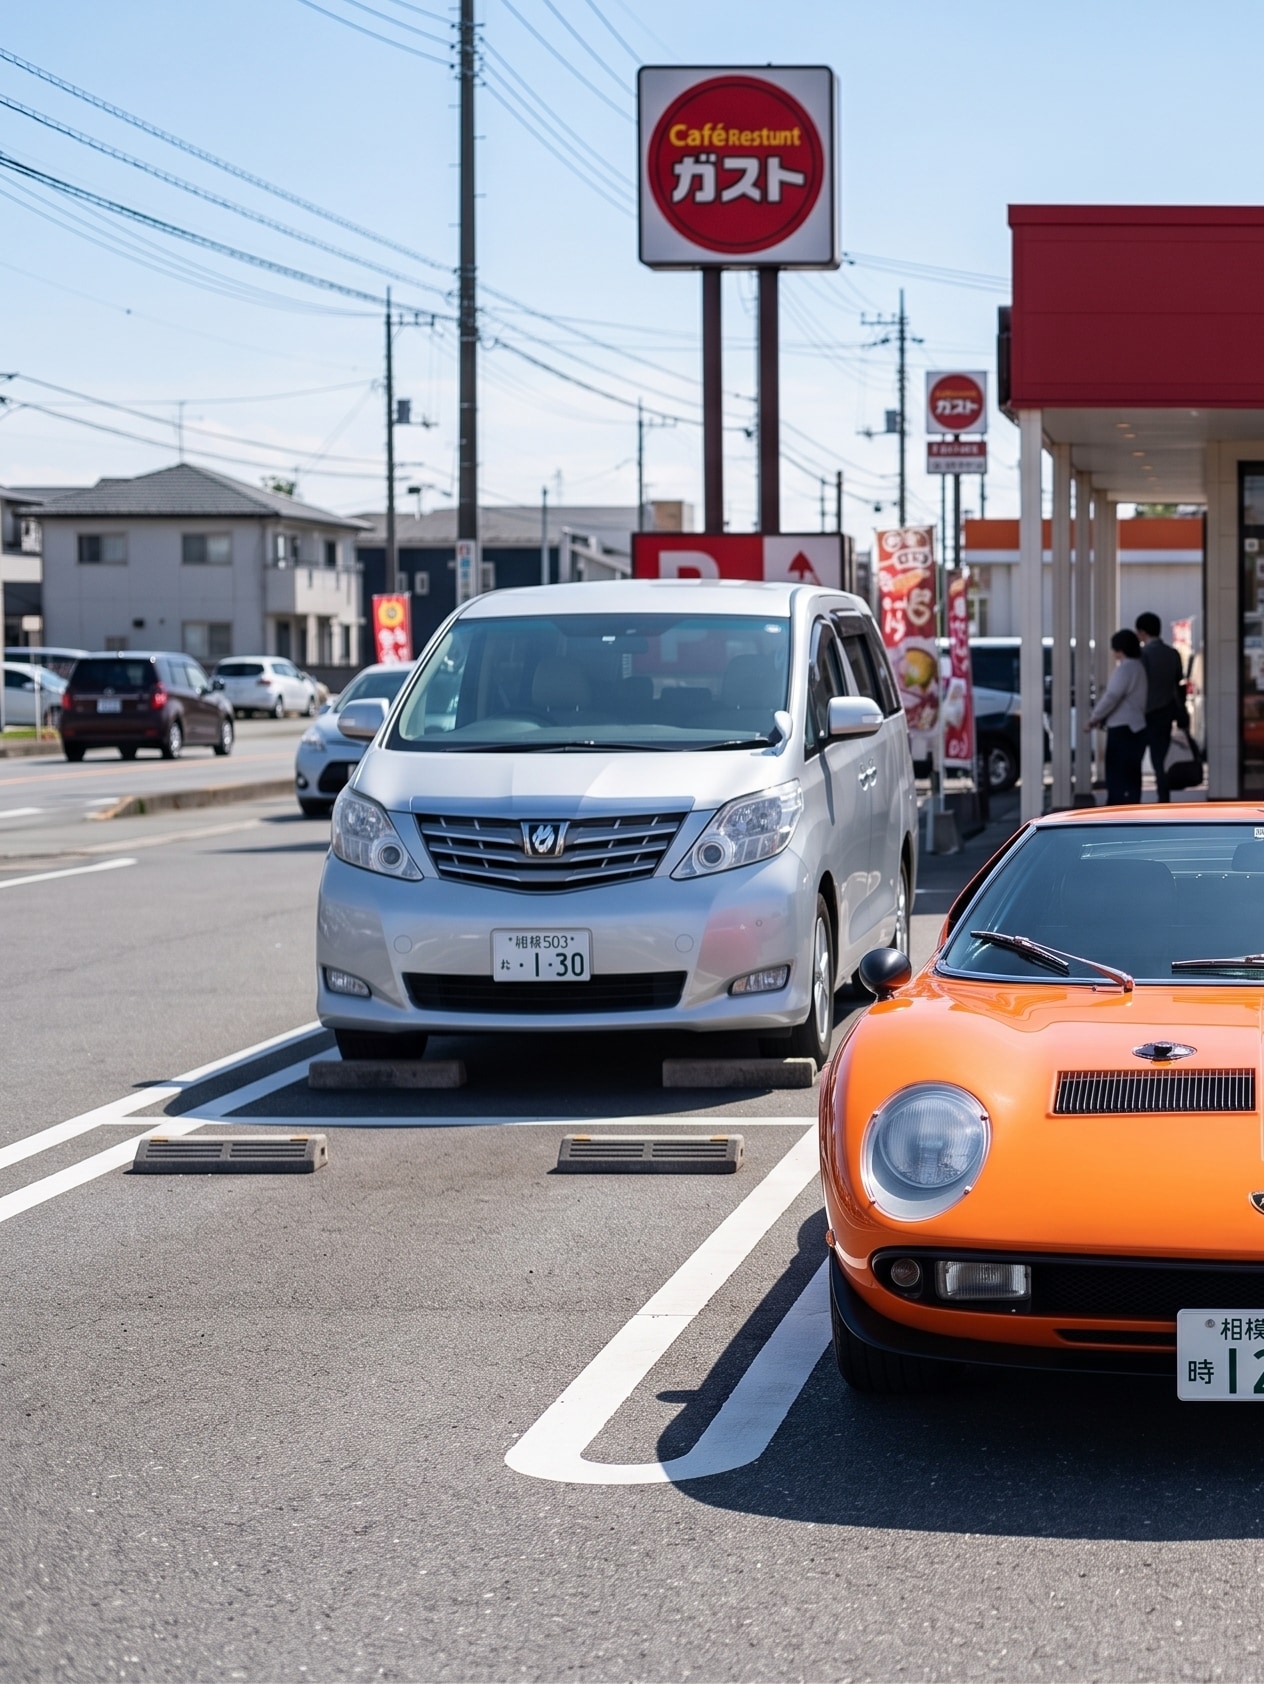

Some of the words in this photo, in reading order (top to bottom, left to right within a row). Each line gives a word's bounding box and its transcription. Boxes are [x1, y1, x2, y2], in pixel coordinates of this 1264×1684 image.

[671, 153, 805, 203] ガスト
[935, 399, 979, 415] ガスト
[1188, 1359, 1214, 1384] 時
